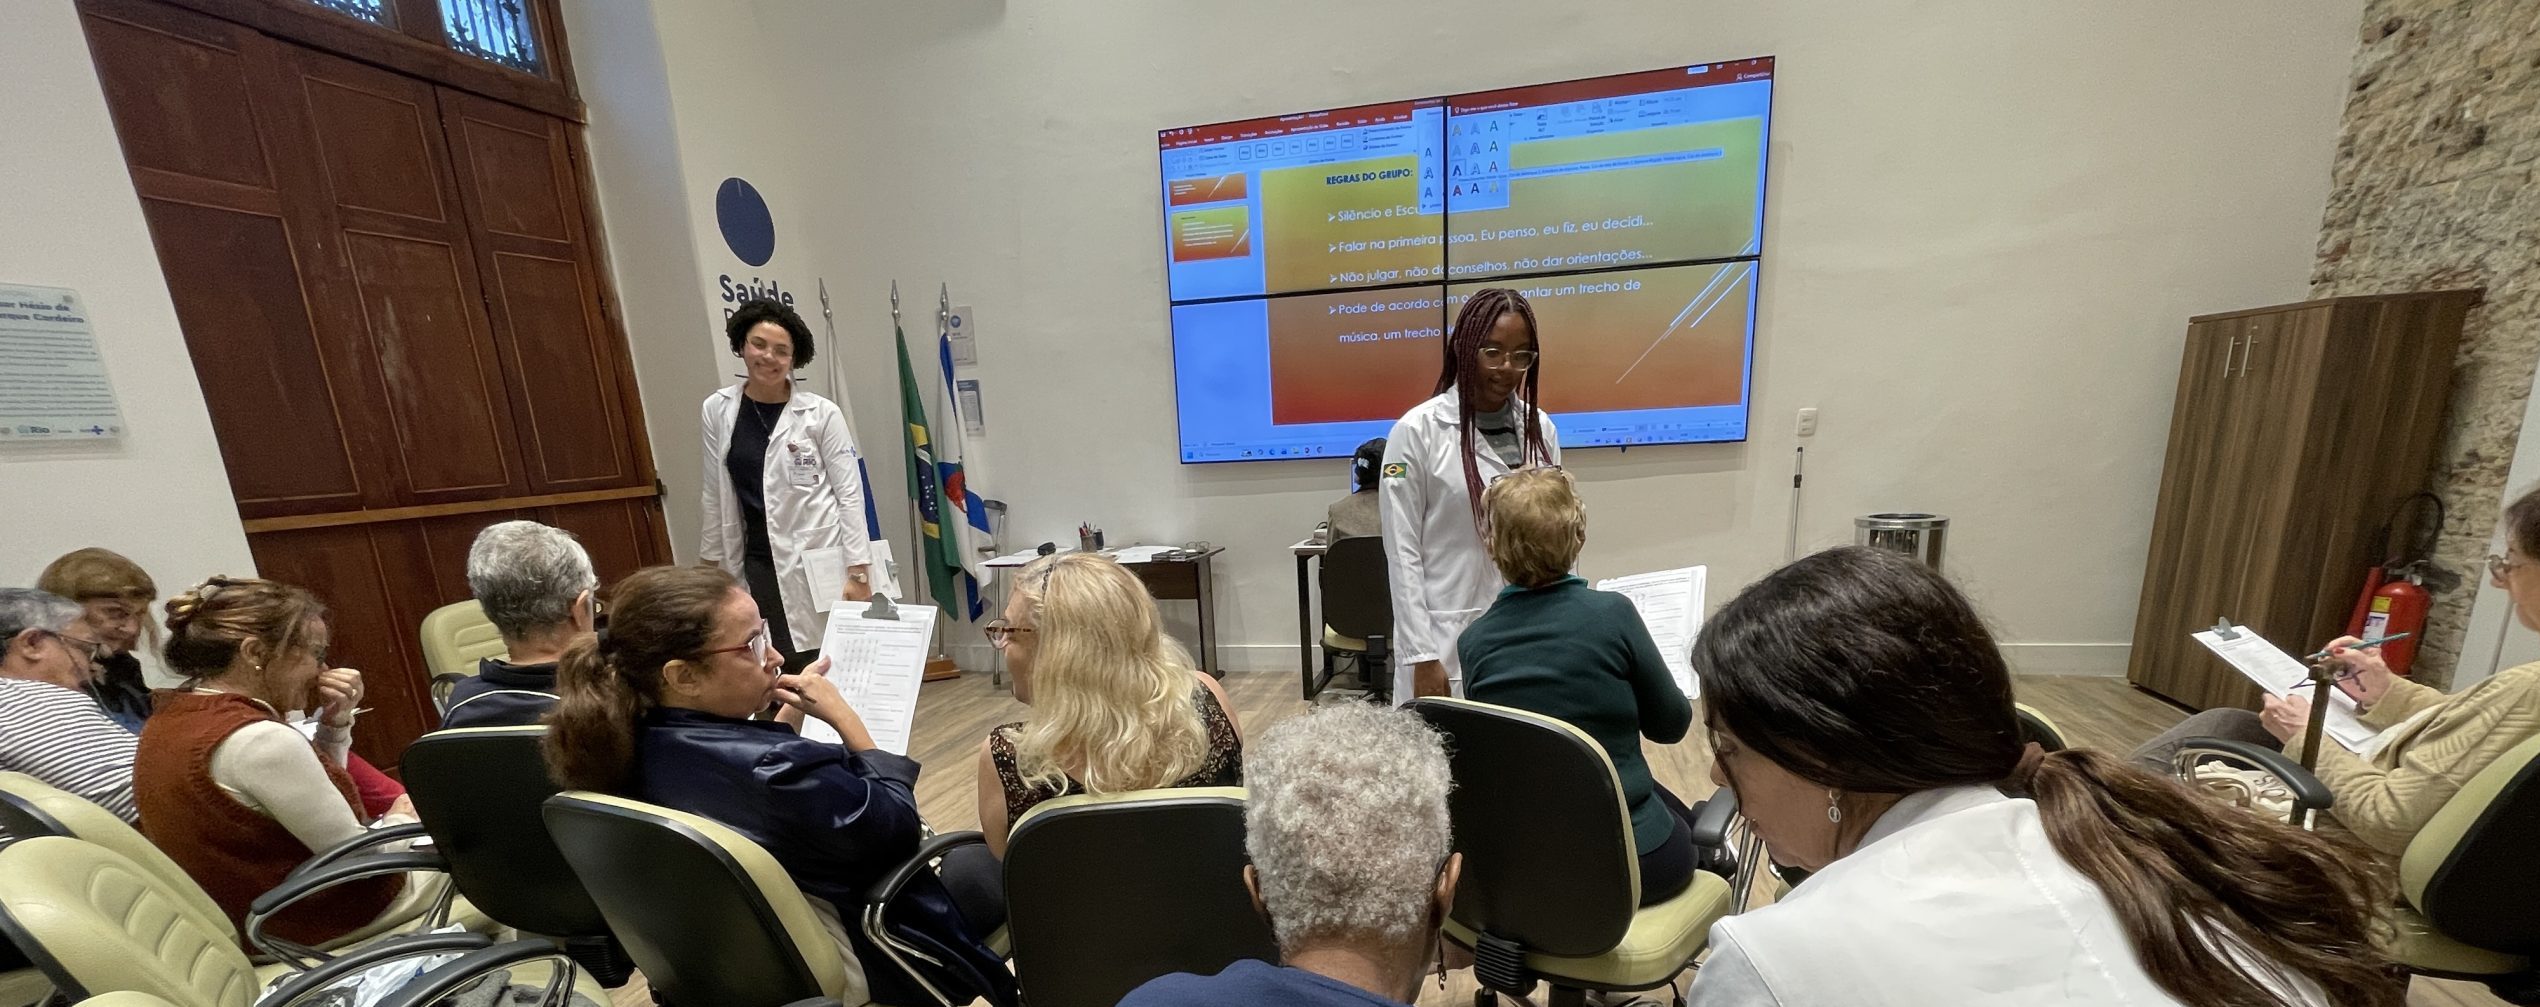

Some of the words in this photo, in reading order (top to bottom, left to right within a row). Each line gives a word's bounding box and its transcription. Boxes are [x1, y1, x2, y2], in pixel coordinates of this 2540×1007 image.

[1489, 120, 1498, 132] A
[1424, 147, 1432, 158] A
[1489, 141, 1498, 152] A
[1489, 161, 1498, 172] A
[1326, 173, 1360, 185] REGRAS
[1362, 171, 1376, 182] DO
[1379, 168, 1413, 180] GRUPO:
[1424, 187, 1433, 198] A
[1453, 185, 1462, 196] A
[1471, 183, 1480, 194] A
[1338, 208, 1381, 222] Silêncio
[1384, 208, 1392, 217] e
[1338, 241, 1366, 252] Falar
[1370, 240, 1385, 249] na
[1388, 235, 1436, 250] primeira
[1481, 229, 1495, 241] Eu
[1543, 226, 1559, 235] eu
[1582, 222, 1598, 232] eu
[1602, 215, 1654, 230] decidi...
[1340, 271, 1364, 283] Não
[1405, 266, 1428, 277] não
[1514, 258, 1538, 269] não
[1542, 255, 1564, 267] dar
[719, 274, 794, 307] Saúde
[1338, 303, 1367, 314] Pode
[1371, 301, 1385, 312] de
[1388, 299, 1430, 311] acordo
[1555, 285, 1575, 296] um
[1579, 280, 1619, 294] trecho
[1624, 279, 1641, 291] de
[1384, 330, 1401, 340] um
[1405, 327, 1440, 338] trecho
